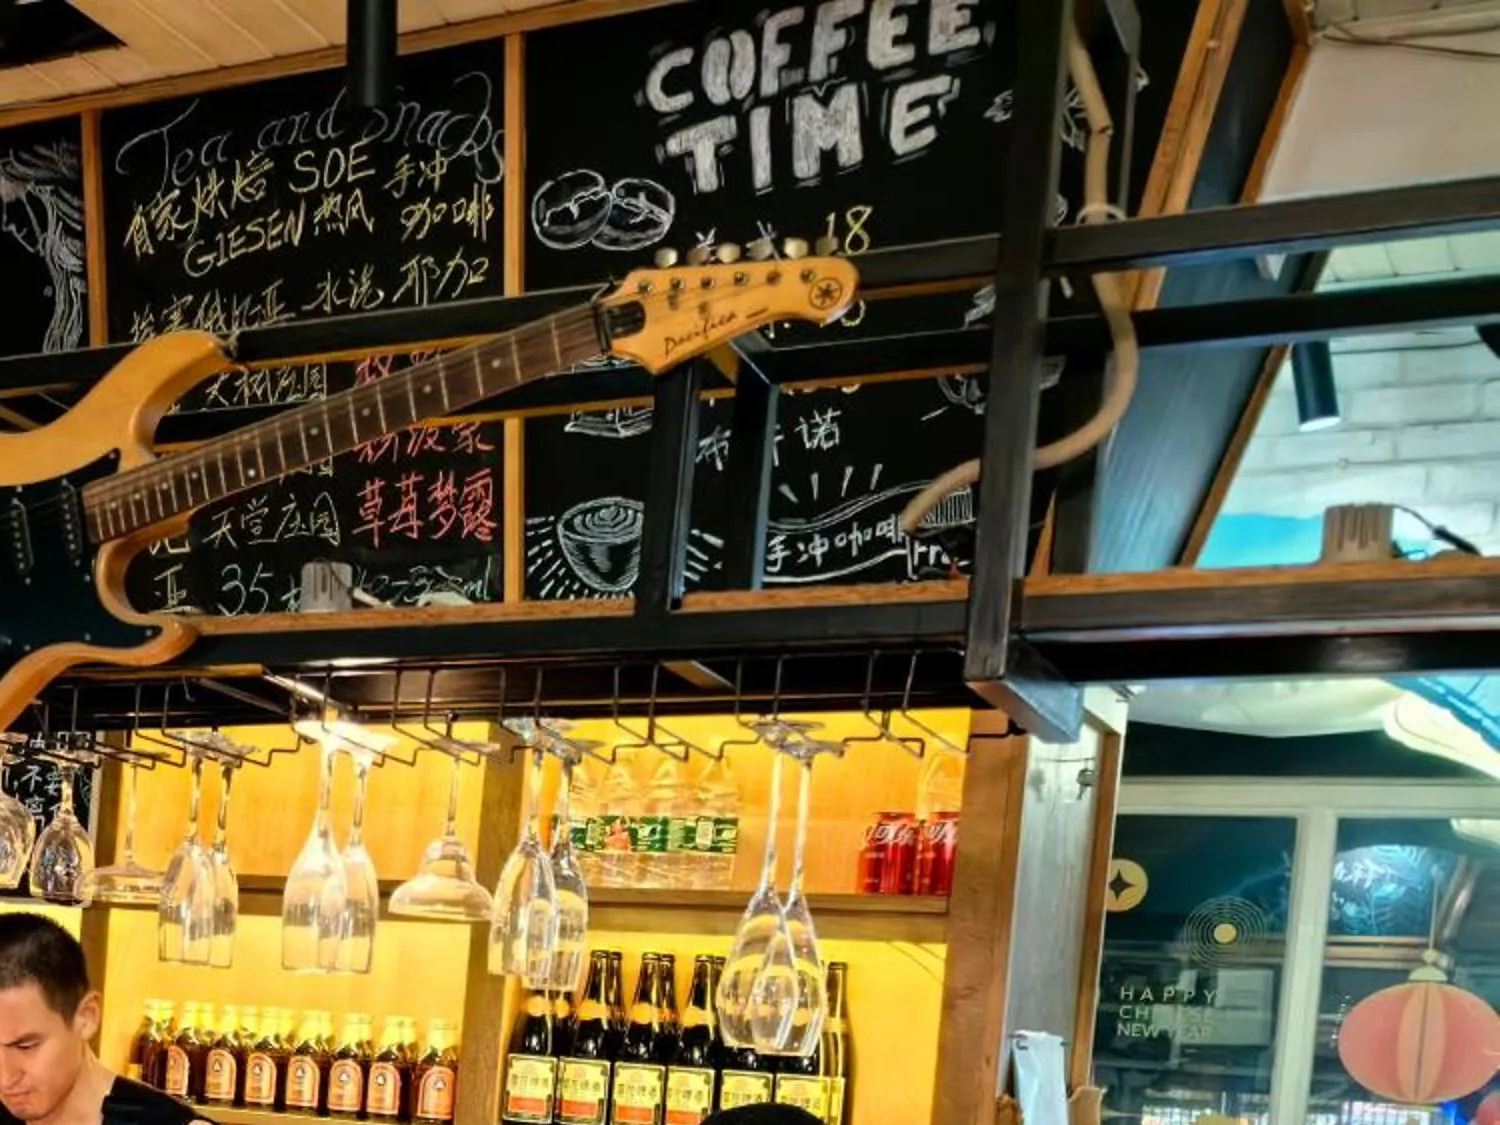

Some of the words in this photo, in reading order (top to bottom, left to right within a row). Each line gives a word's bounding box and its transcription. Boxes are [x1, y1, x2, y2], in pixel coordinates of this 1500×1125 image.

[645, 0, 982, 113] COFFEE
[115, 98, 234, 200] Tea
[256, 86, 347, 152] and
[665, 75, 953, 194] TIME
[288, 137, 376, 193] SOE
[382, 149, 449, 198] 手冲
[400, 182, 495, 243] 咖啡
[1119, 984, 1218, 1004] HAPPY
[1116, 1021, 1161, 1038] NEW
